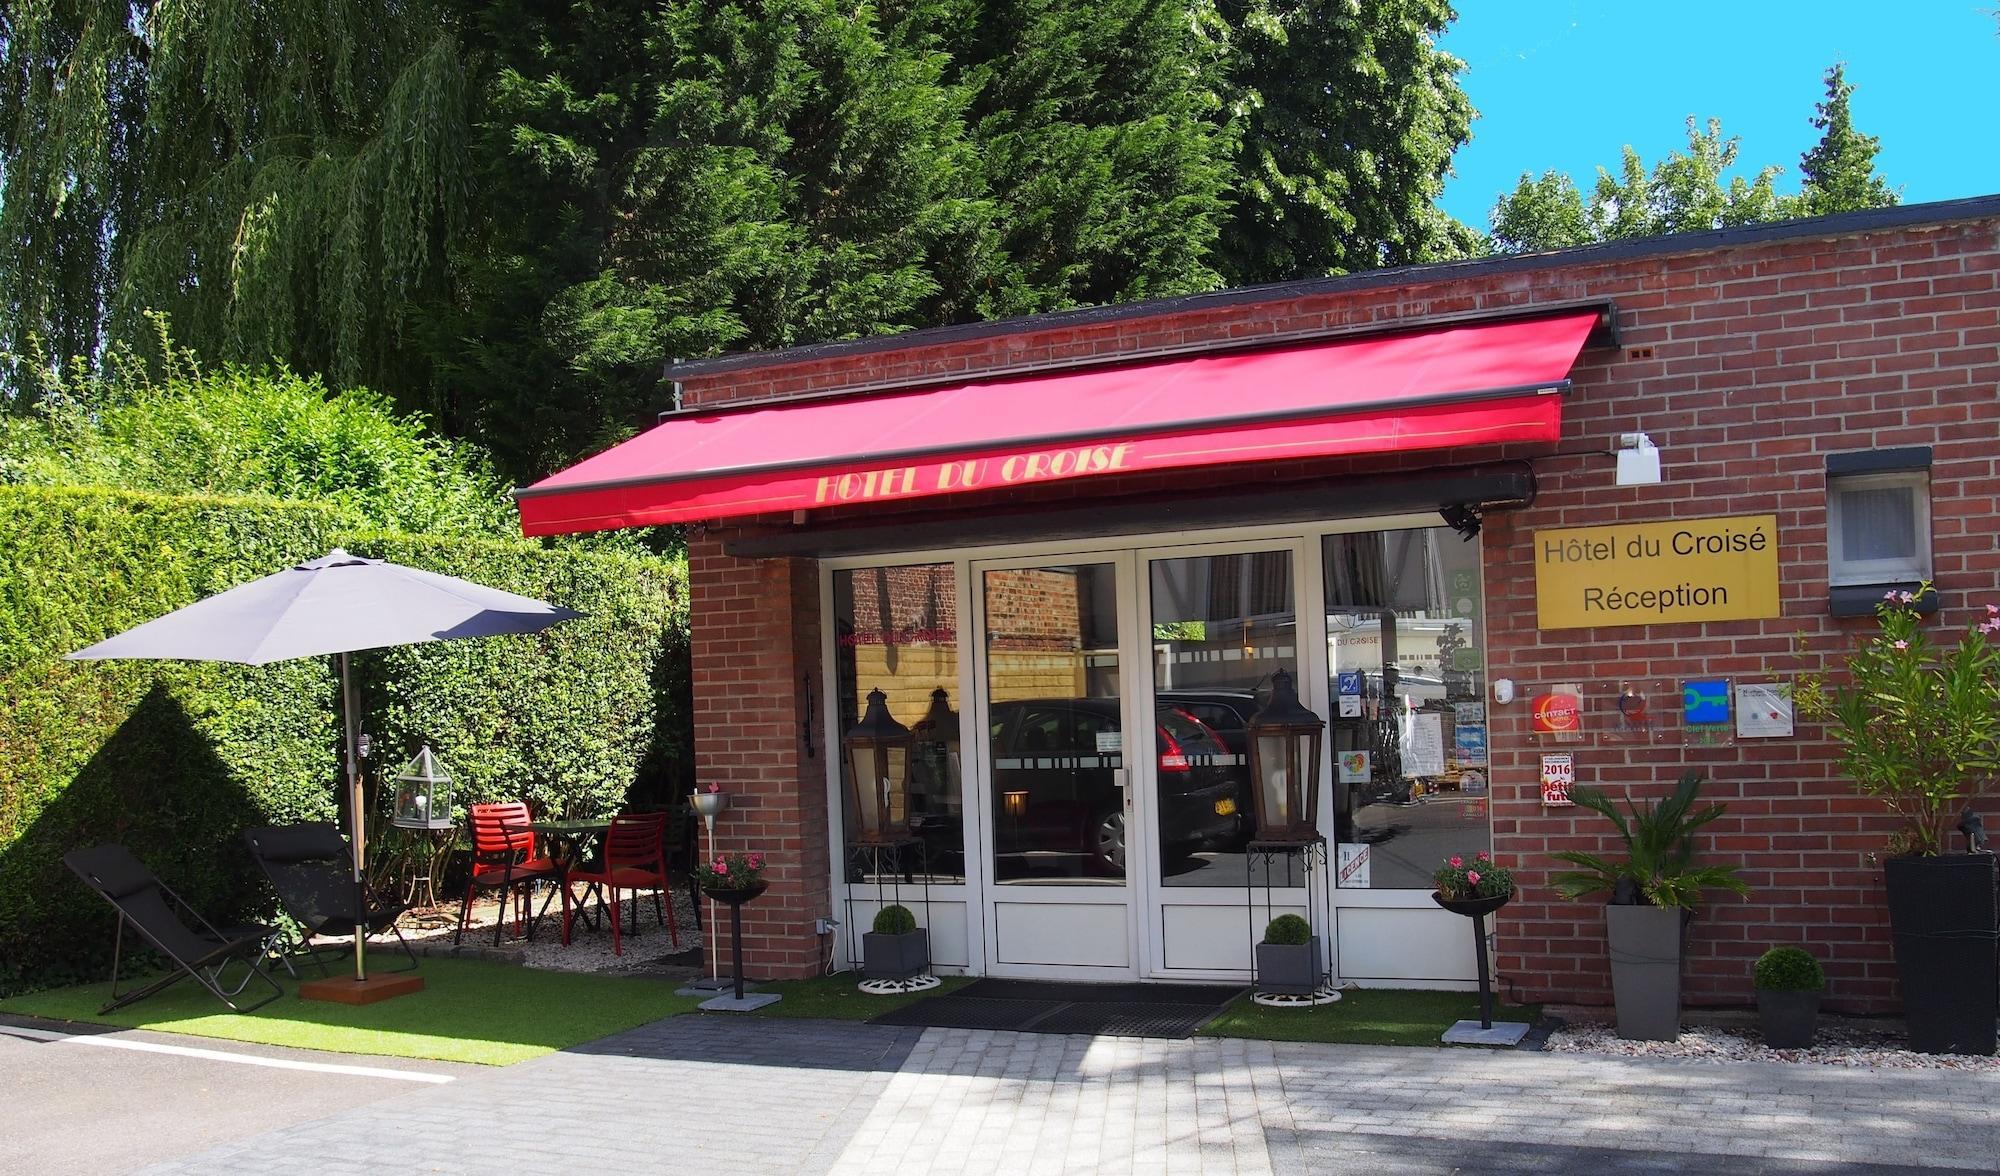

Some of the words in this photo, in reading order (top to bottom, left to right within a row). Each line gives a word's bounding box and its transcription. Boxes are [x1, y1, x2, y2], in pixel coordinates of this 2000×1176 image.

[815, 466, 920, 503] HOTEL
[937, 460, 988, 490] DU
[1544, 535, 1616, 563] Hôtel
[1626, 534, 1661, 558] du
[1672, 526, 1766, 555] Croisé
[1584, 582, 1728, 613] Réception
[1544, 764, 1571, 775] 2016
